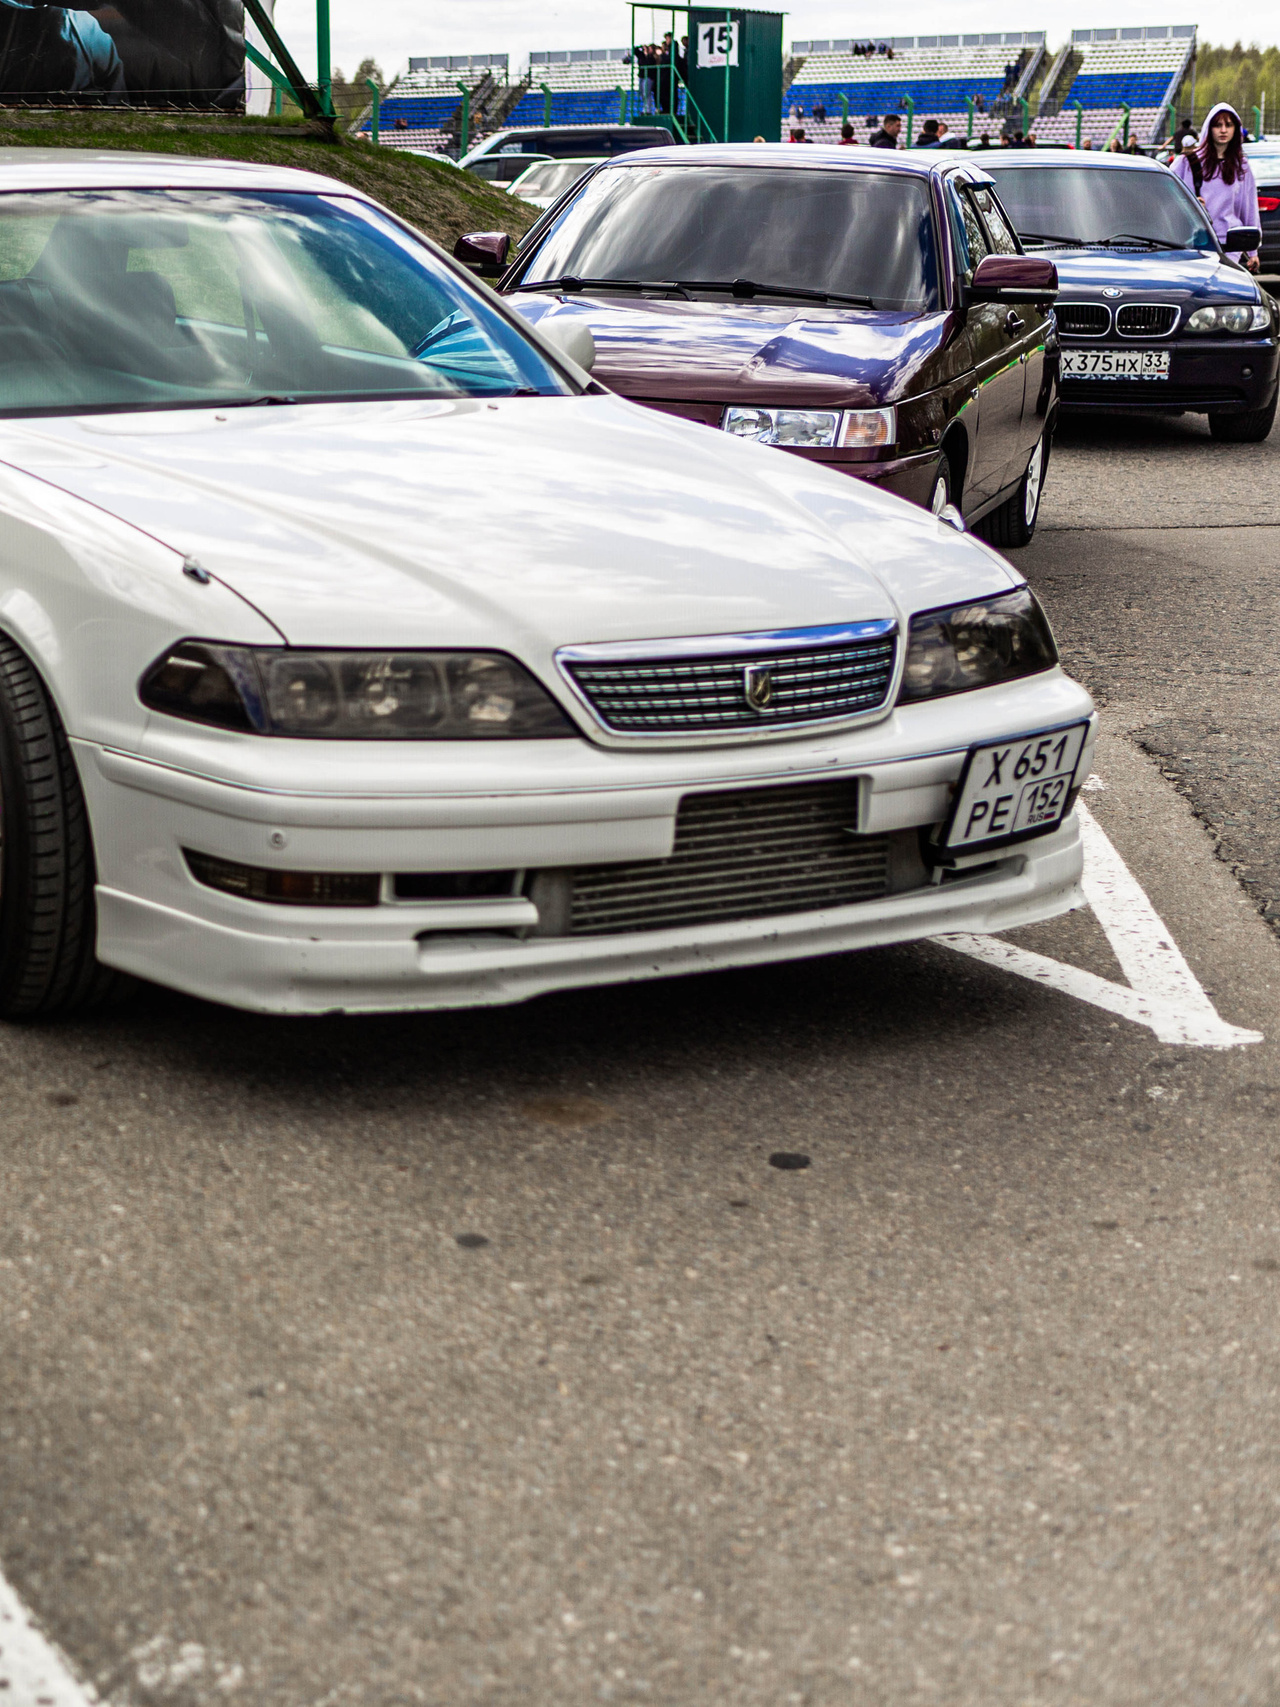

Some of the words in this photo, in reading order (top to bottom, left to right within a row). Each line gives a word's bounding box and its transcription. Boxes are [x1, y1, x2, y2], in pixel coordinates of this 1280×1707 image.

[703, 26, 733, 54] 15
[1144, 354, 1162, 367] 33
[1027, 779, 1065, 813] 152
[1026, 811, 1045, 824] RUS
